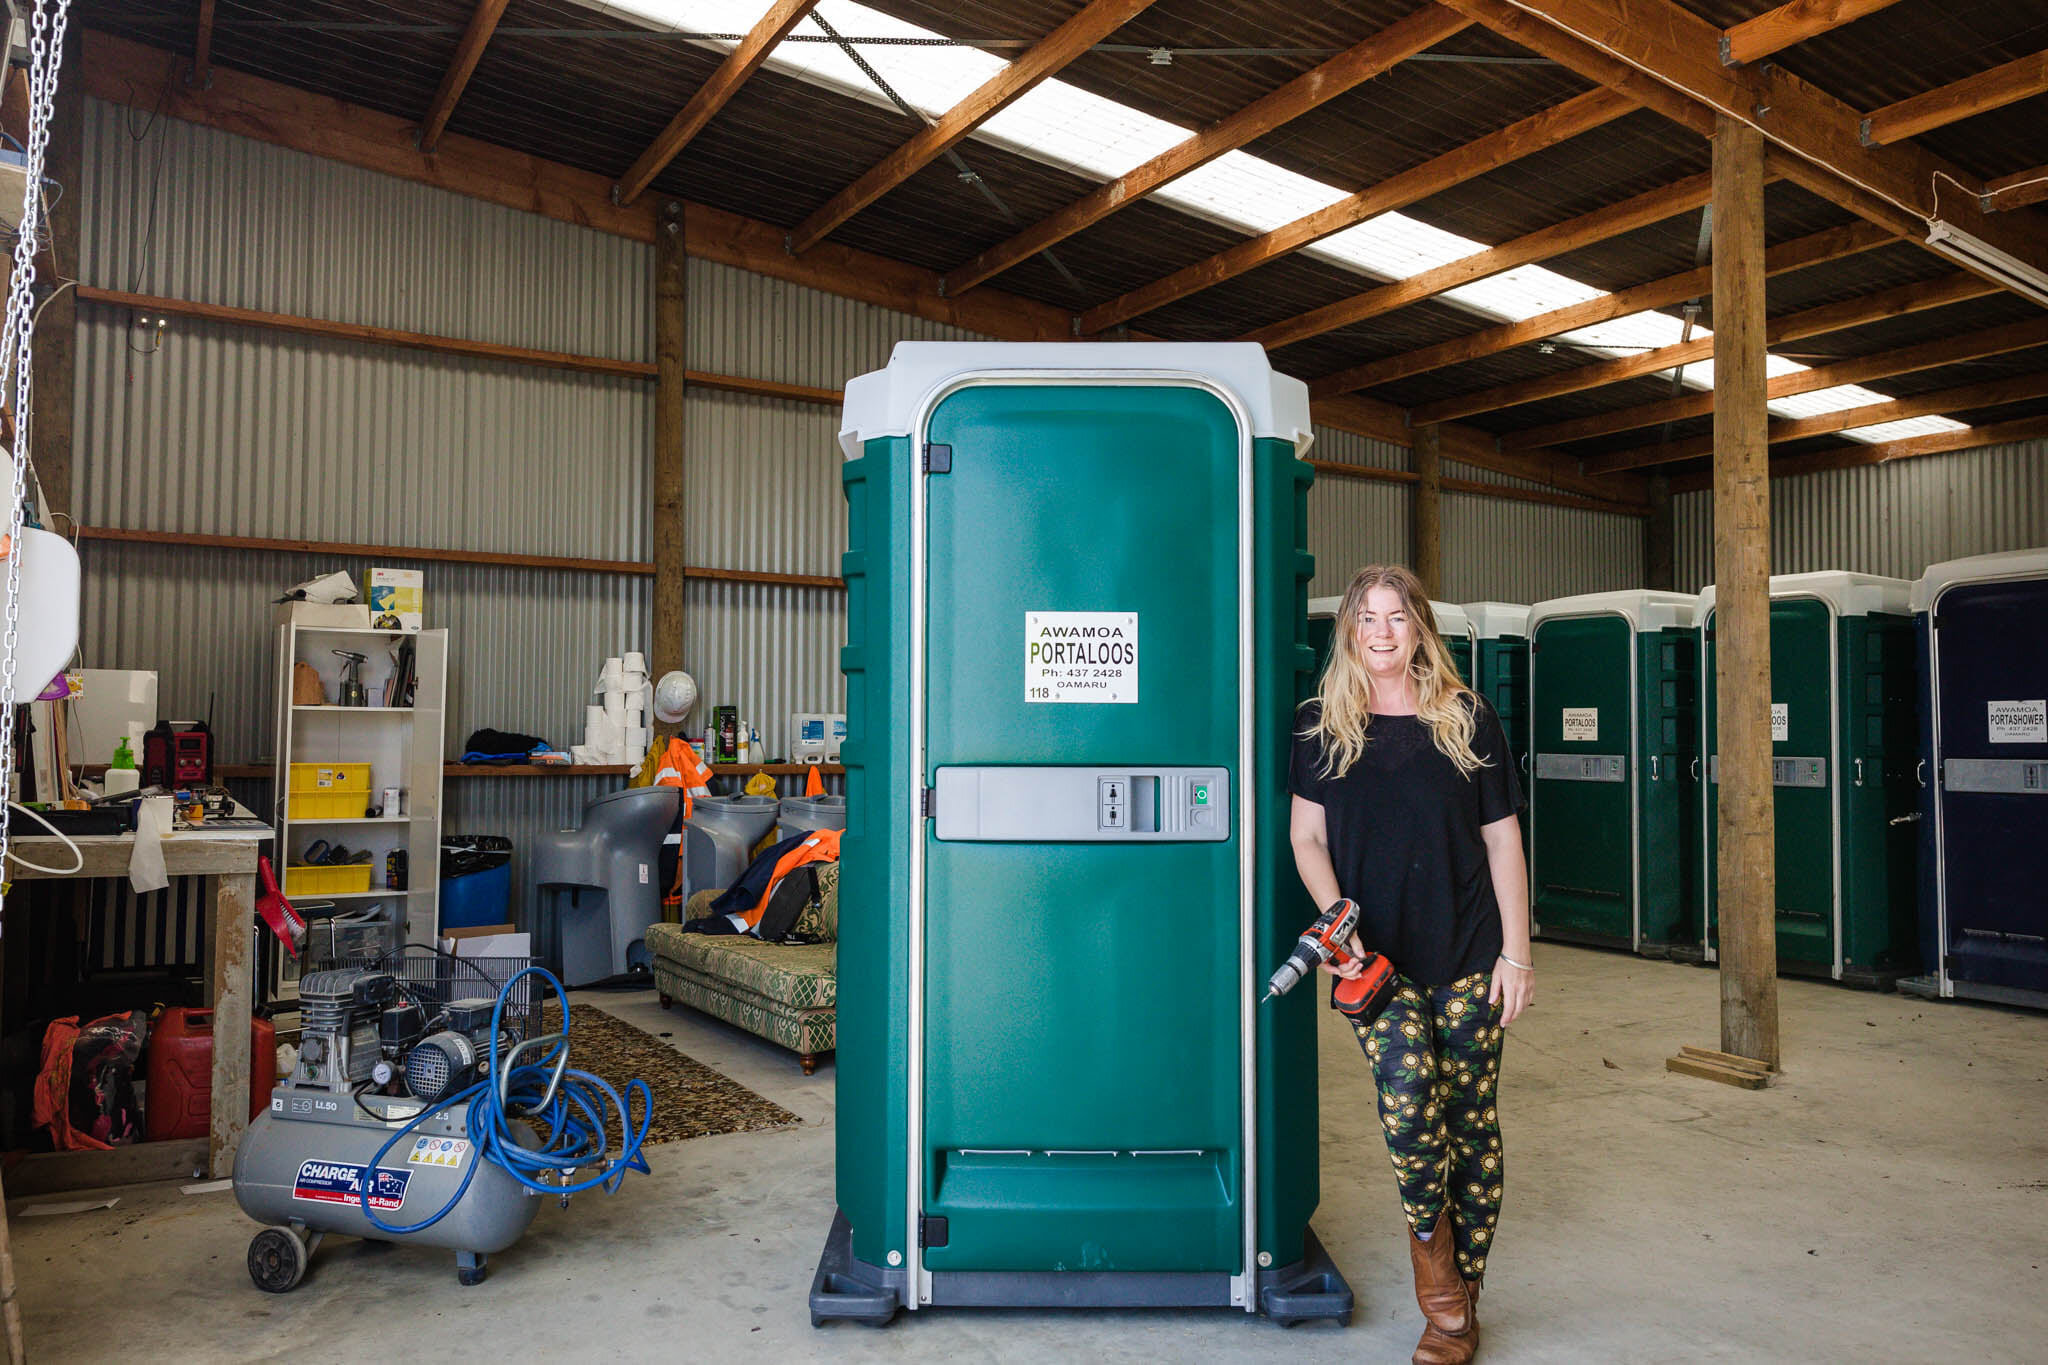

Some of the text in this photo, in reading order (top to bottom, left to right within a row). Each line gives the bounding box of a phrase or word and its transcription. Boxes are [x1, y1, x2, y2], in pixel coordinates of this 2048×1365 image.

[1040, 627, 1124, 638] AWAMOA
[1030, 642, 1134, 664] PORTALOOS
[1042, 669, 1122, 678] Ph: 437 2428
[1057, 681, 1107, 689] OAMARU
[1030, 687, 1049, 698] 118
[1564, 718, 1596, 727] PORTALOOS
[1990, 714, 2044, 725] PORTASHOWER
[435, 1112, 449, 1120] 2.5
[301, 1164, 358, 1182] CHARGE
